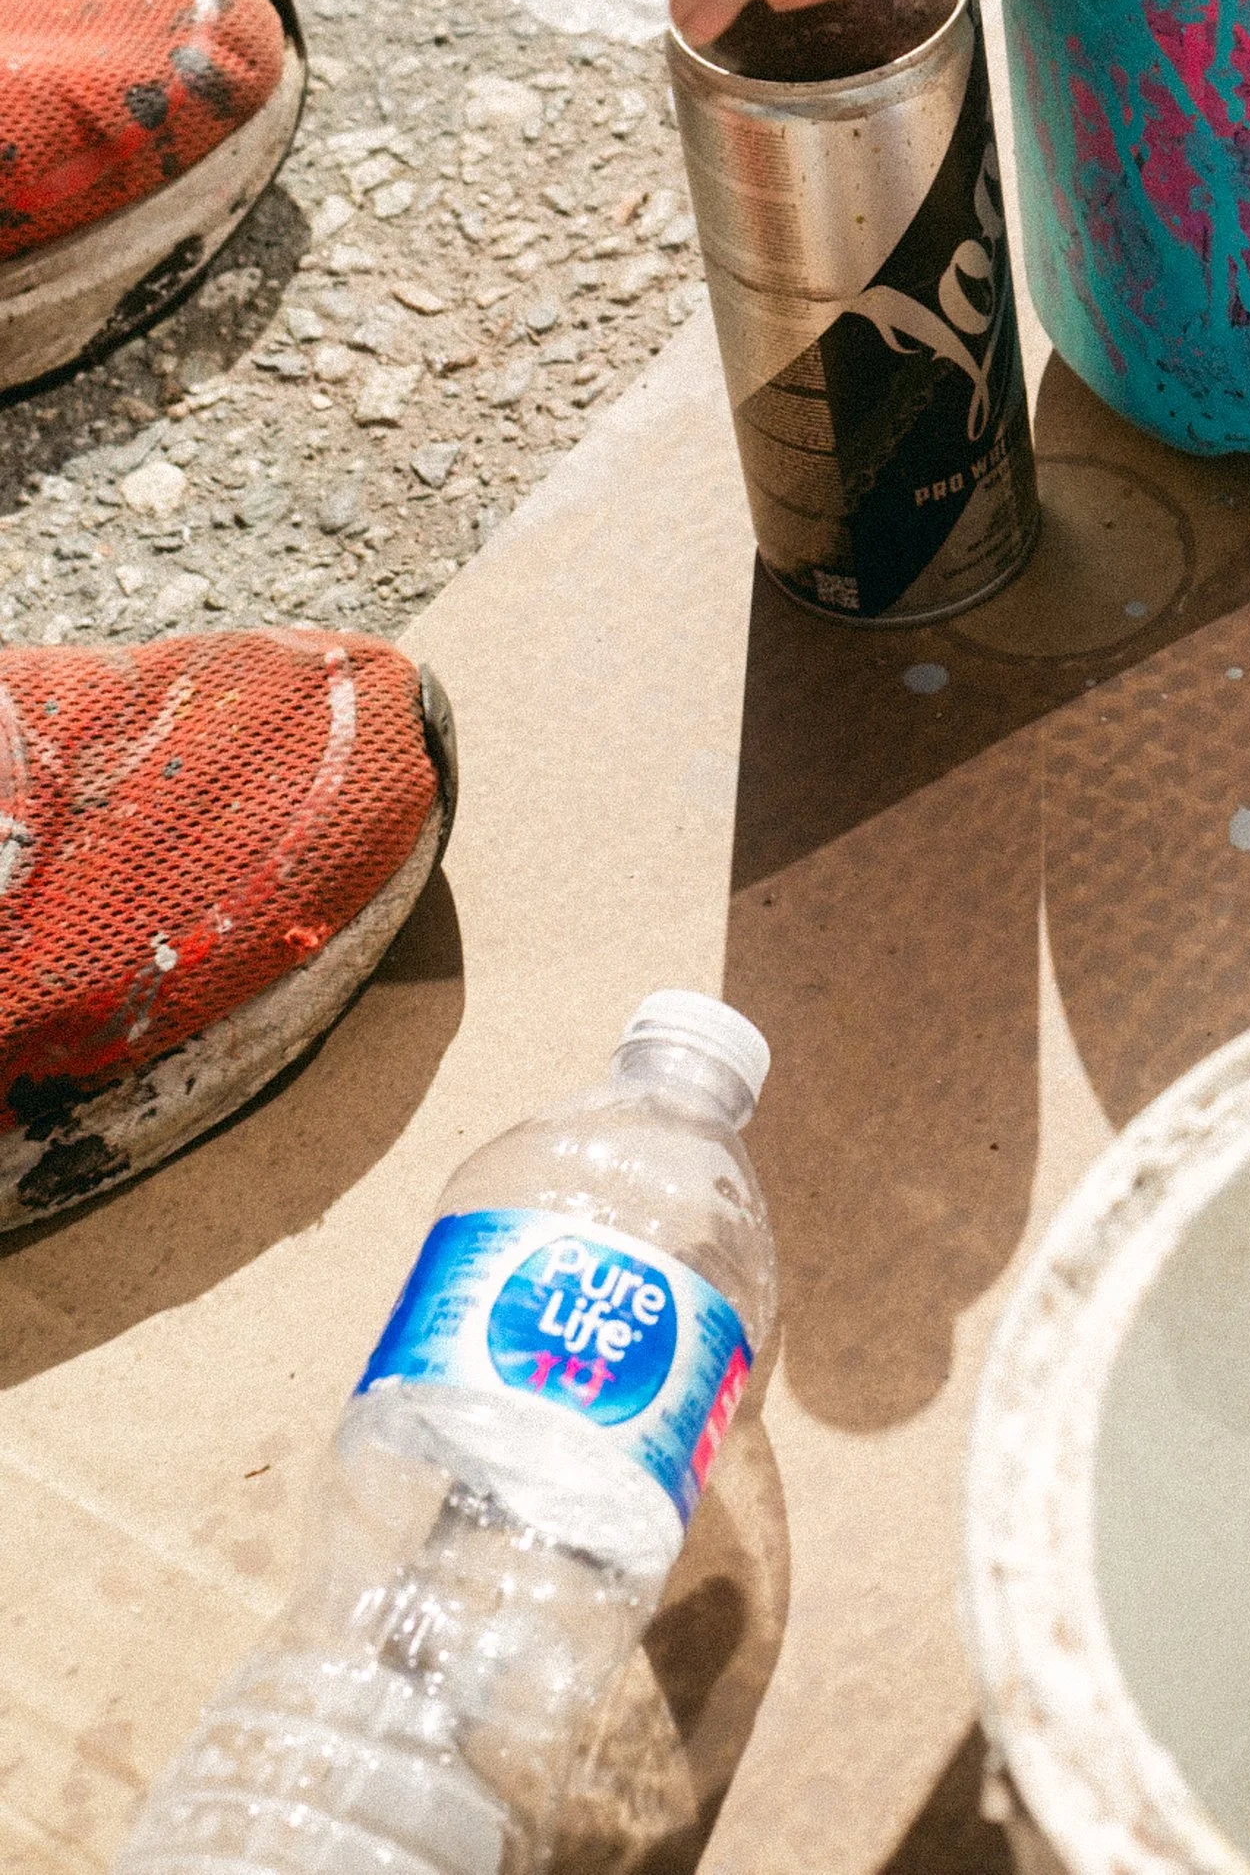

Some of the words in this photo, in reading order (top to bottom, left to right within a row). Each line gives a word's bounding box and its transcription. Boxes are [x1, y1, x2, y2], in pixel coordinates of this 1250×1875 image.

[914, 472, 964, 507] PRO
[542, 1239, 666, 1325] Pure
[538, 1289, 632, 1362] Life
